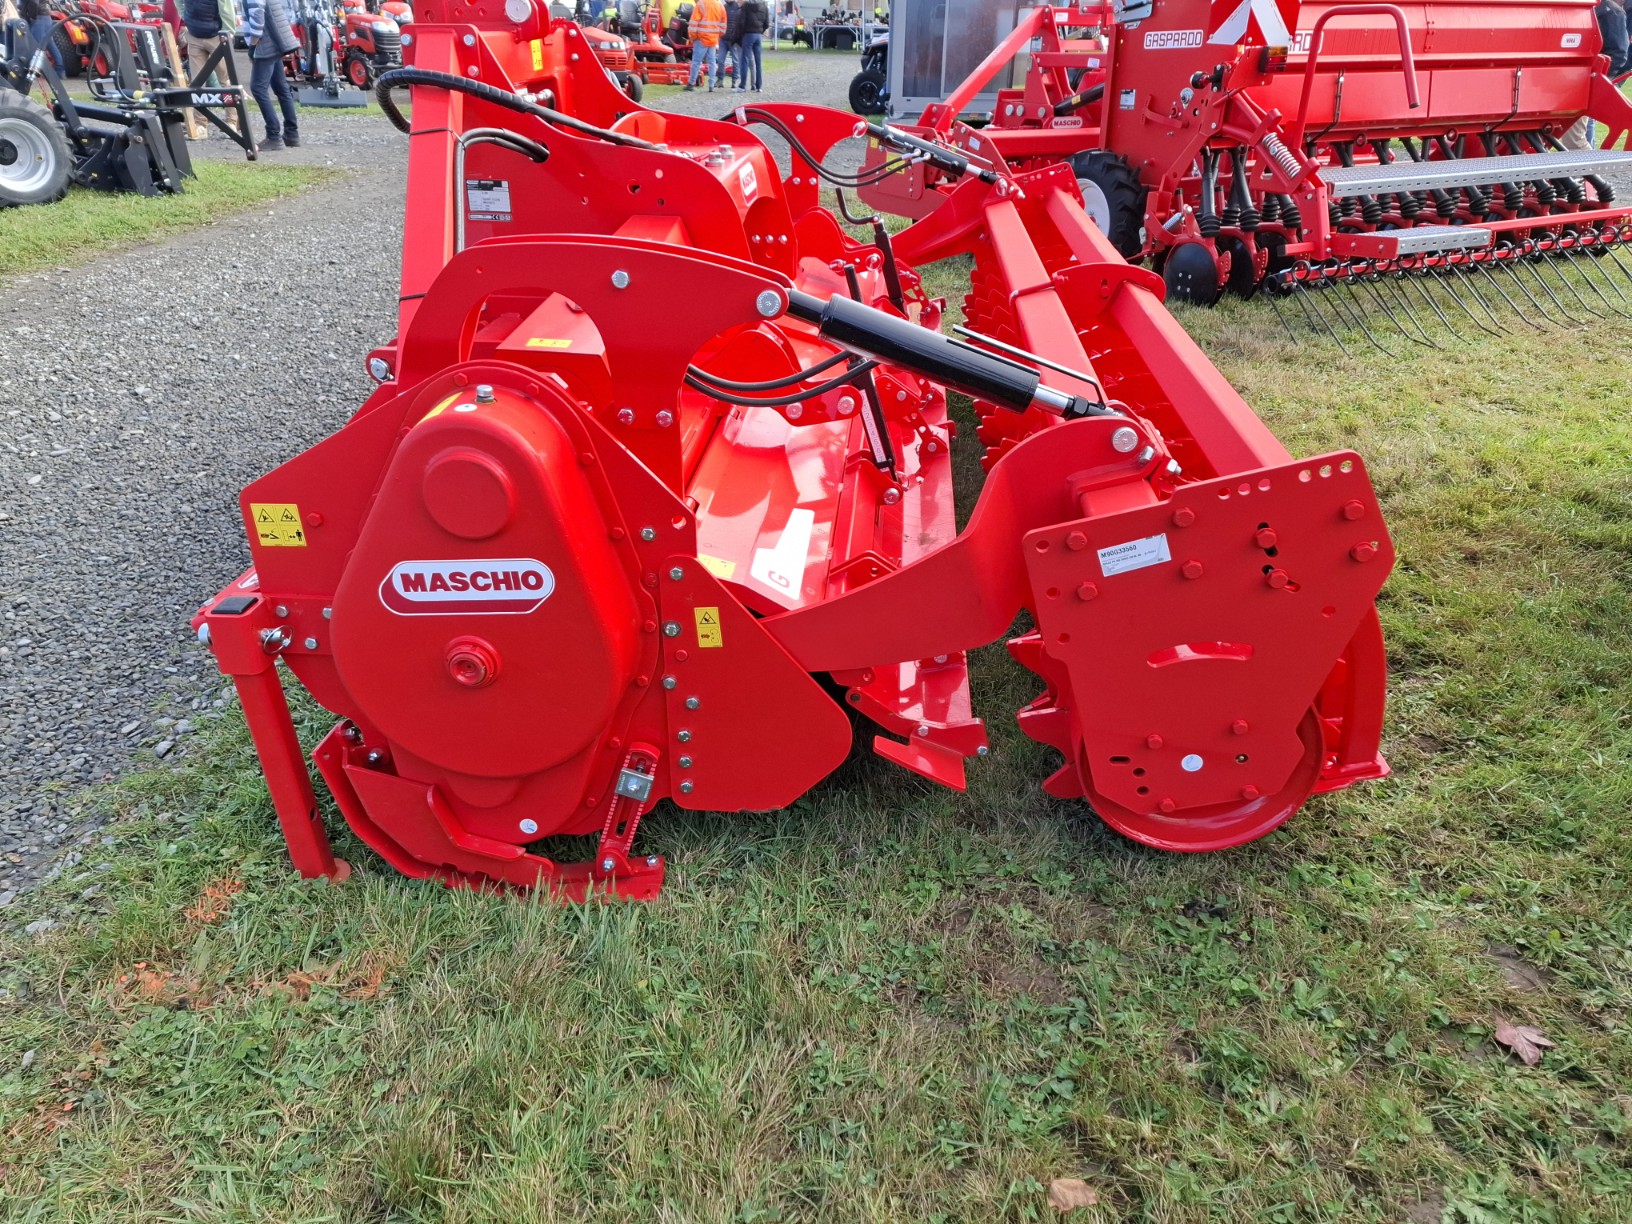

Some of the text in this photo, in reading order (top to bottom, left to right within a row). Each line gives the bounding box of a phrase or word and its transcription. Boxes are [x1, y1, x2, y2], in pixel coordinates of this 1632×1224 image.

[1145, 31, 1202, 47] GASPARDO
[190, 92, 223, 104] MX
[400, 570, 544, 593] MASCHIO
